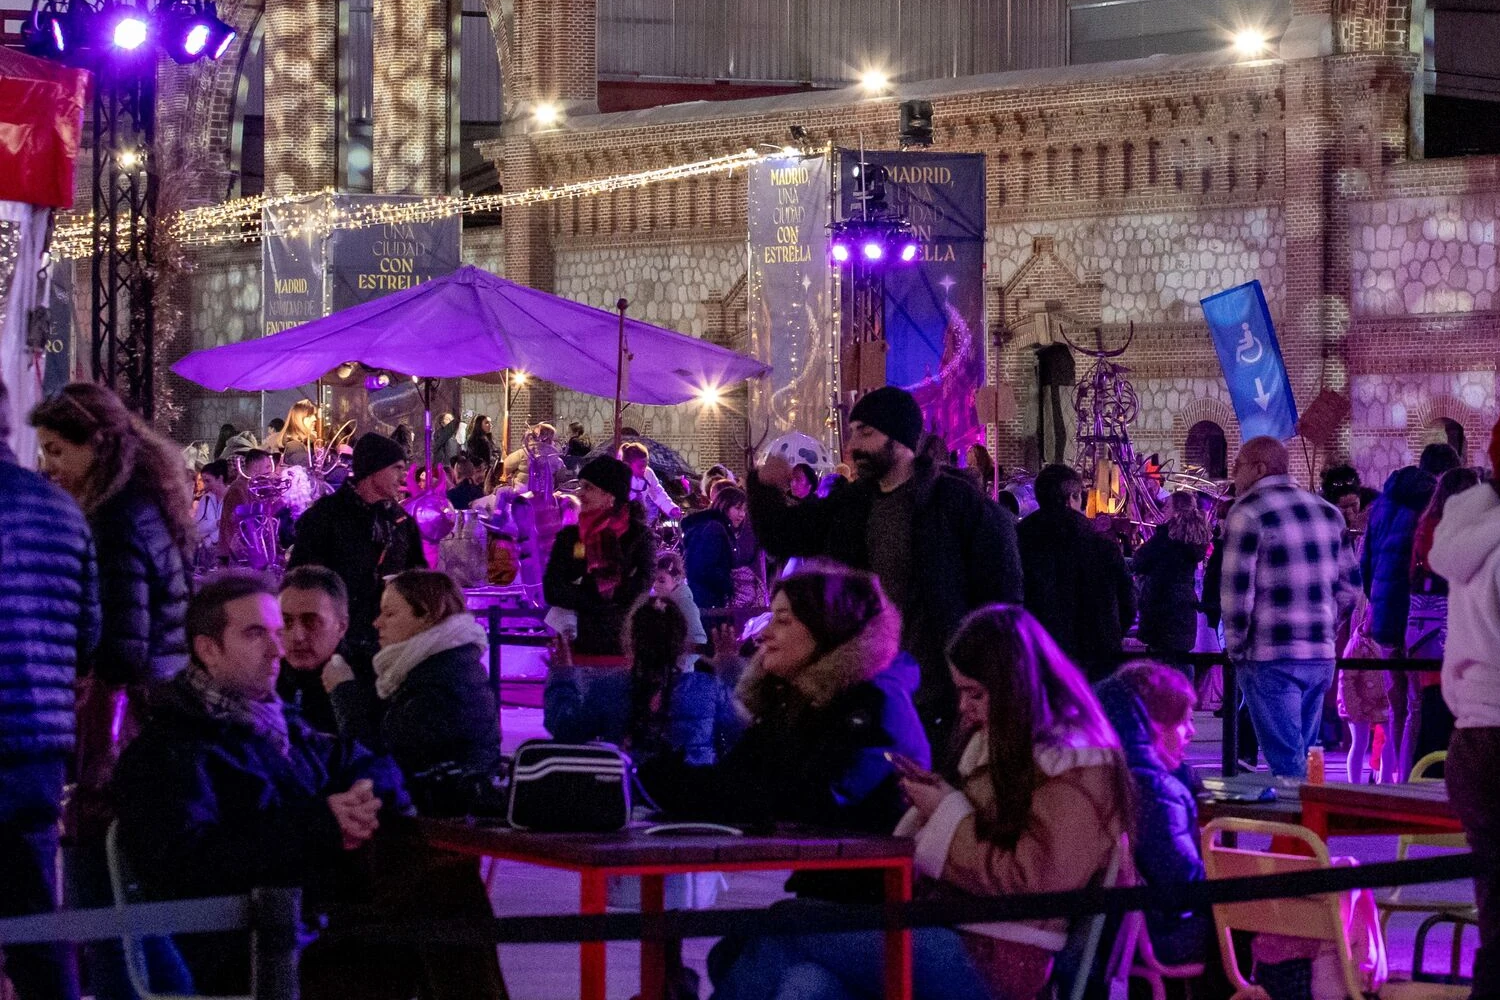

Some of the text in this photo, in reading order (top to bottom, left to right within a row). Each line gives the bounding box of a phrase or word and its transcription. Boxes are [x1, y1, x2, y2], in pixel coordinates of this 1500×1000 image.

[779, 187, 799, 205] UNA
[383, 225, 415, 240] UNA
[777, 226, 799, 244] CON
[372, 240, 426, 257] CIUDAD
[764, 245, 812, 264] ESTRELLA
[380, 257, 414, 273] CON
[274, 278, 309, 296] MADRID,
[358, 274, 432, 290] ESTRELL
